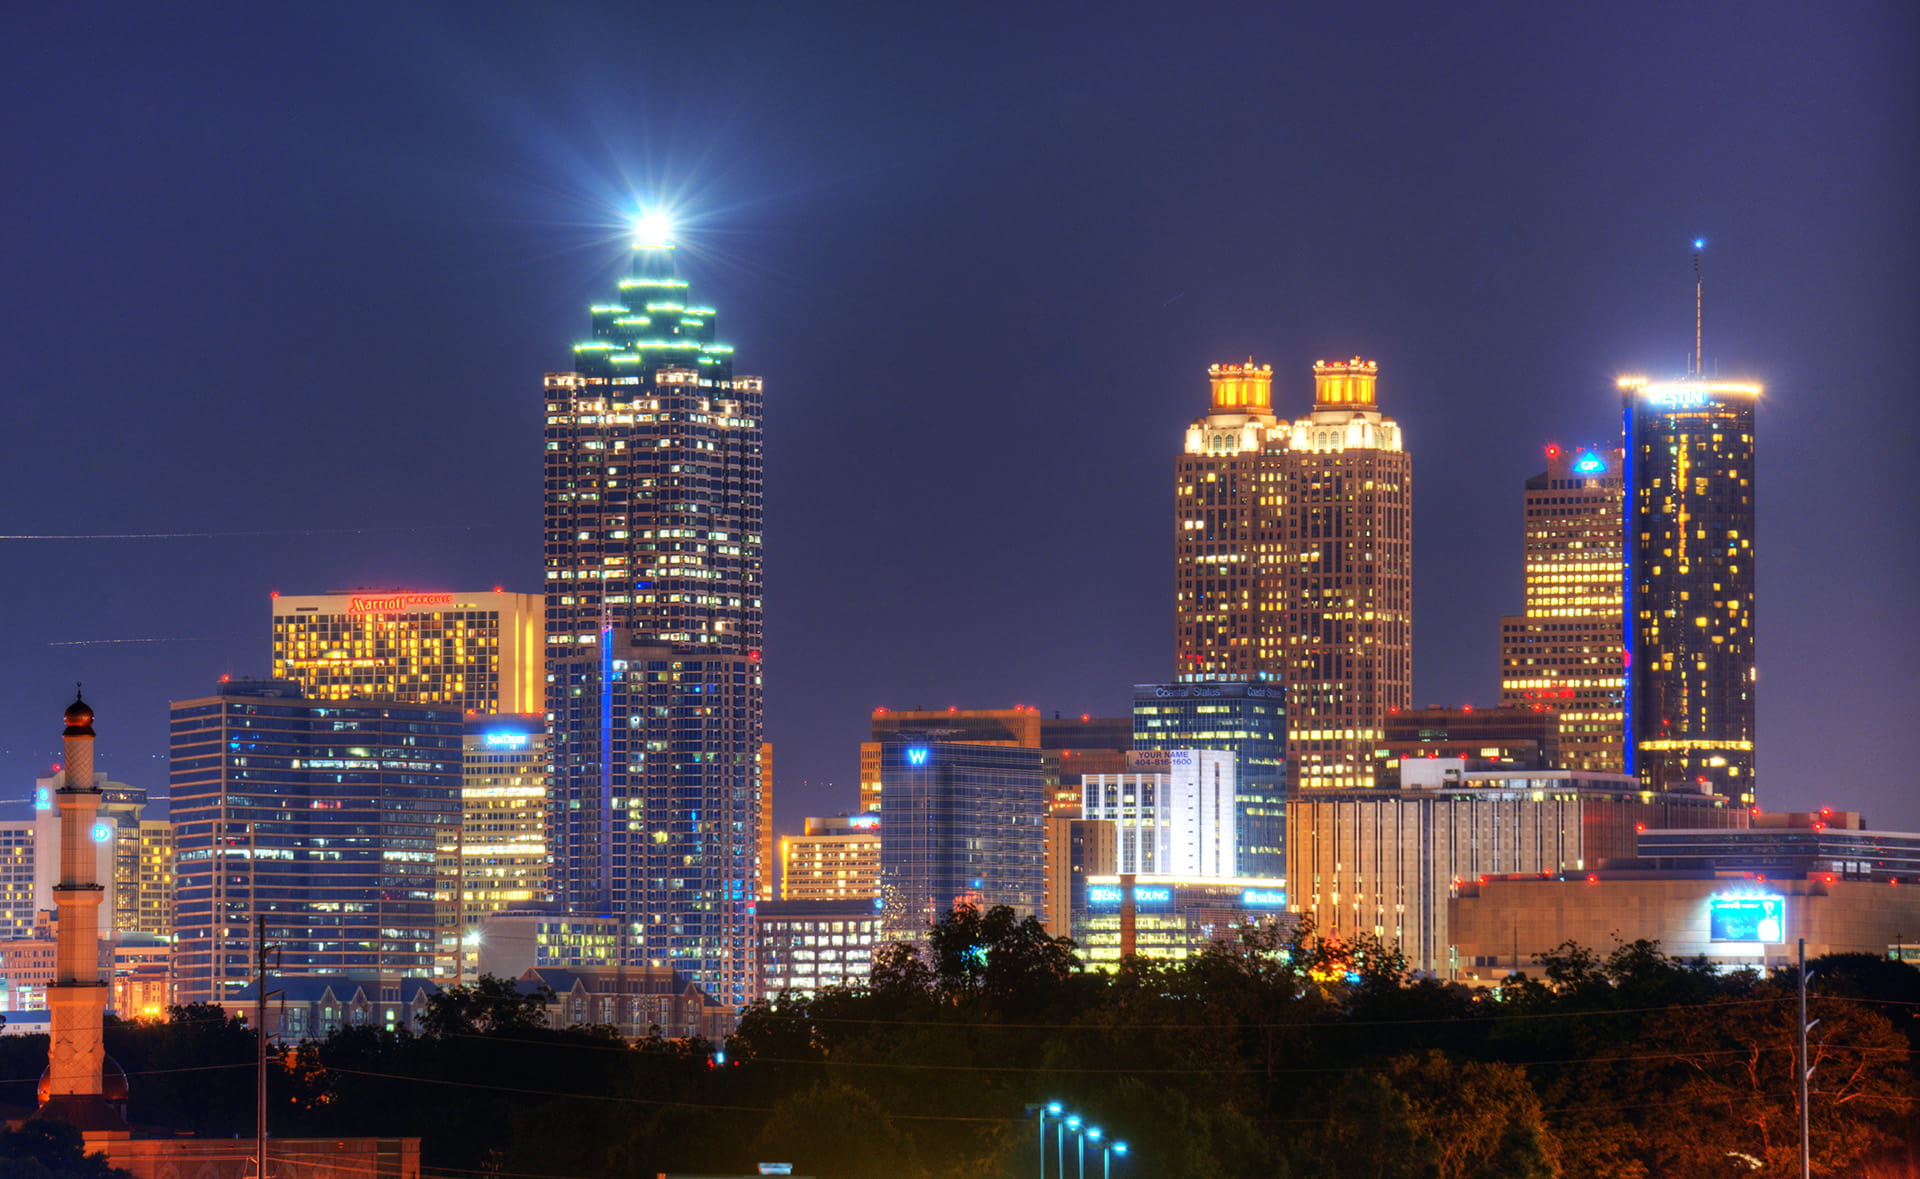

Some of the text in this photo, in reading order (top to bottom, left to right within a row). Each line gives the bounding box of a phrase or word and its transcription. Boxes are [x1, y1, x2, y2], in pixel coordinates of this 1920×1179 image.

[1581, 460, 1598, 470] GP
[349, 595, 453, 613] Marriott MARQUIS
[908, 749, 927, 765] W
[1135, 889, 1169, 900] YOUNG
